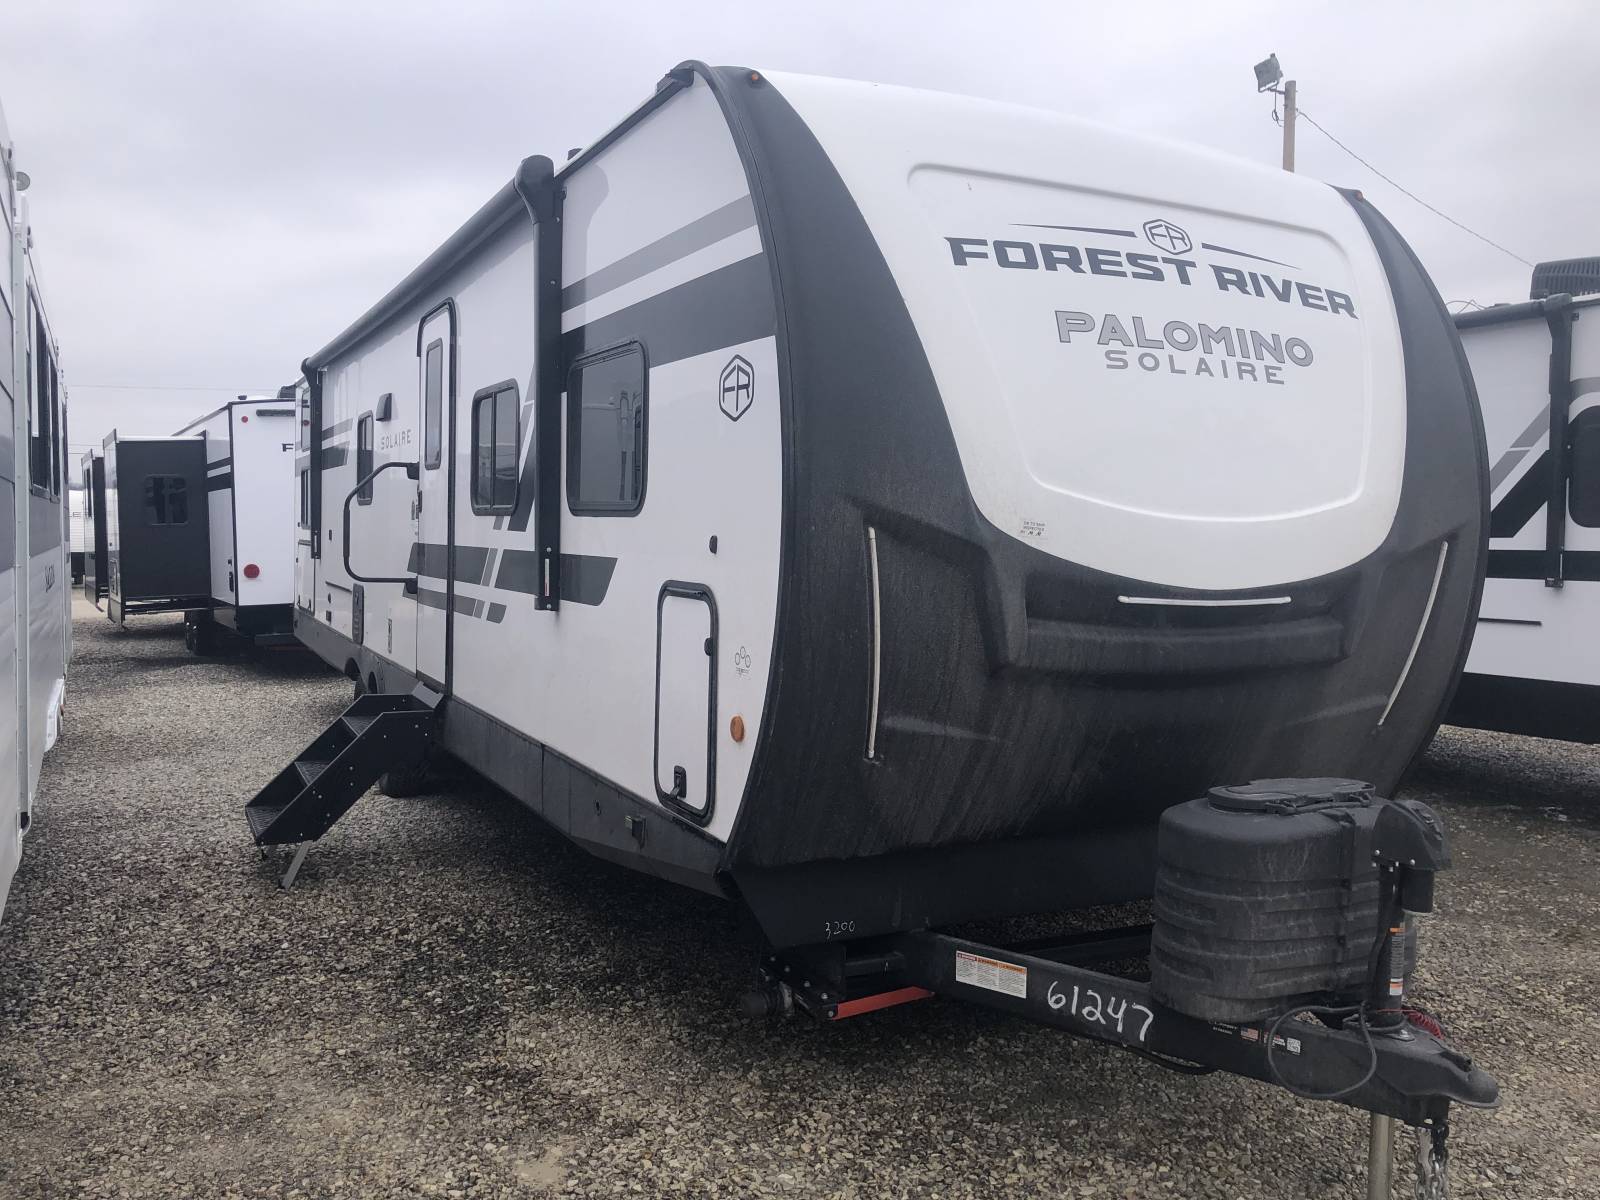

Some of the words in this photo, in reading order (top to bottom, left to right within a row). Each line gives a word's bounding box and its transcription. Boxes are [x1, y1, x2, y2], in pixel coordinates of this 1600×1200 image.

[944, 237, 1197, 286] FOREST
[1208, 263, 1359, 319] RIVER
[1056, 310, 1314, 367] PALOMINO
[1106, 350, 1285, 384] SOLAIRE
[381, 429, 411, 450] SOLAIRE
[1046, 981, 1155, 1041] 61247
